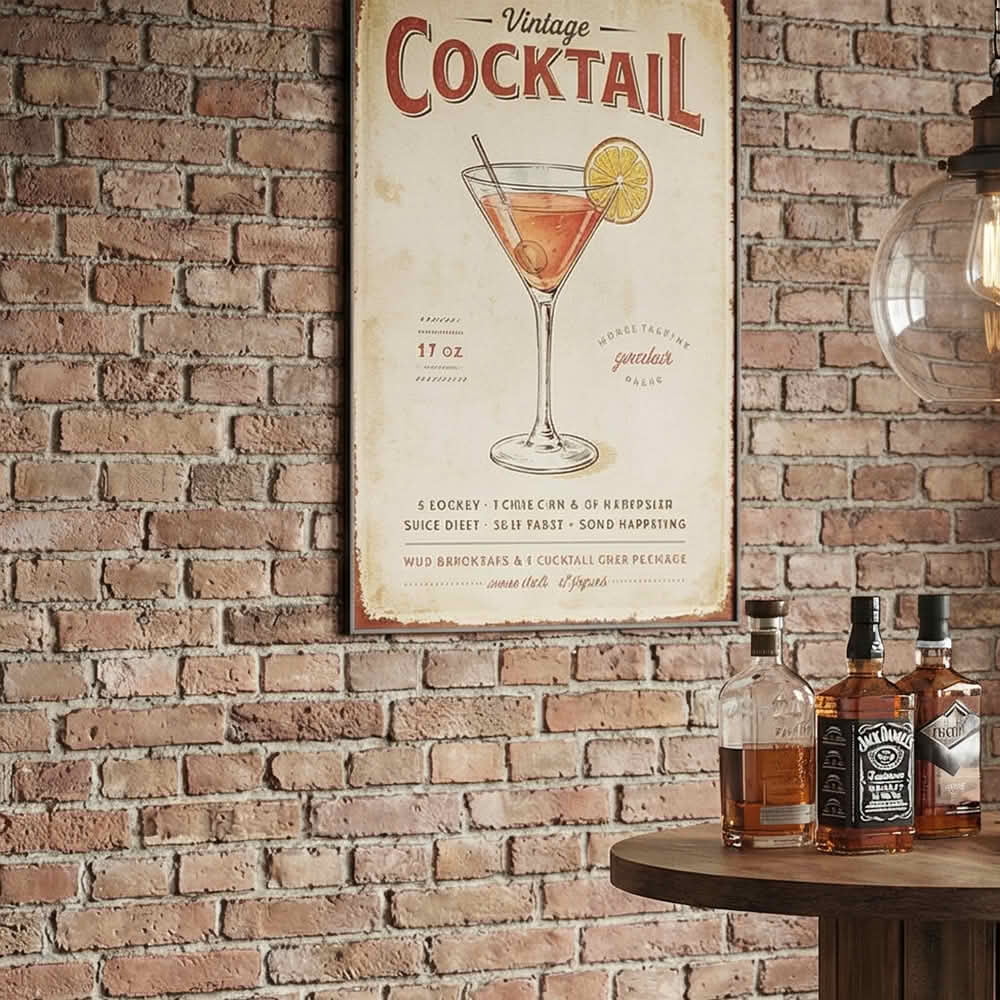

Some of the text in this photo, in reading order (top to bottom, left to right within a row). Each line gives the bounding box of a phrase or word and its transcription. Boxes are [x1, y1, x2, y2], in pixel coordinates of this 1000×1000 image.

[501, 8, 591, 46] Vintage
[386, 16, 704, 136] COCKTAIL
[417, 342, 437, 358] 17
[403, 519, 441, 532] SUICE
